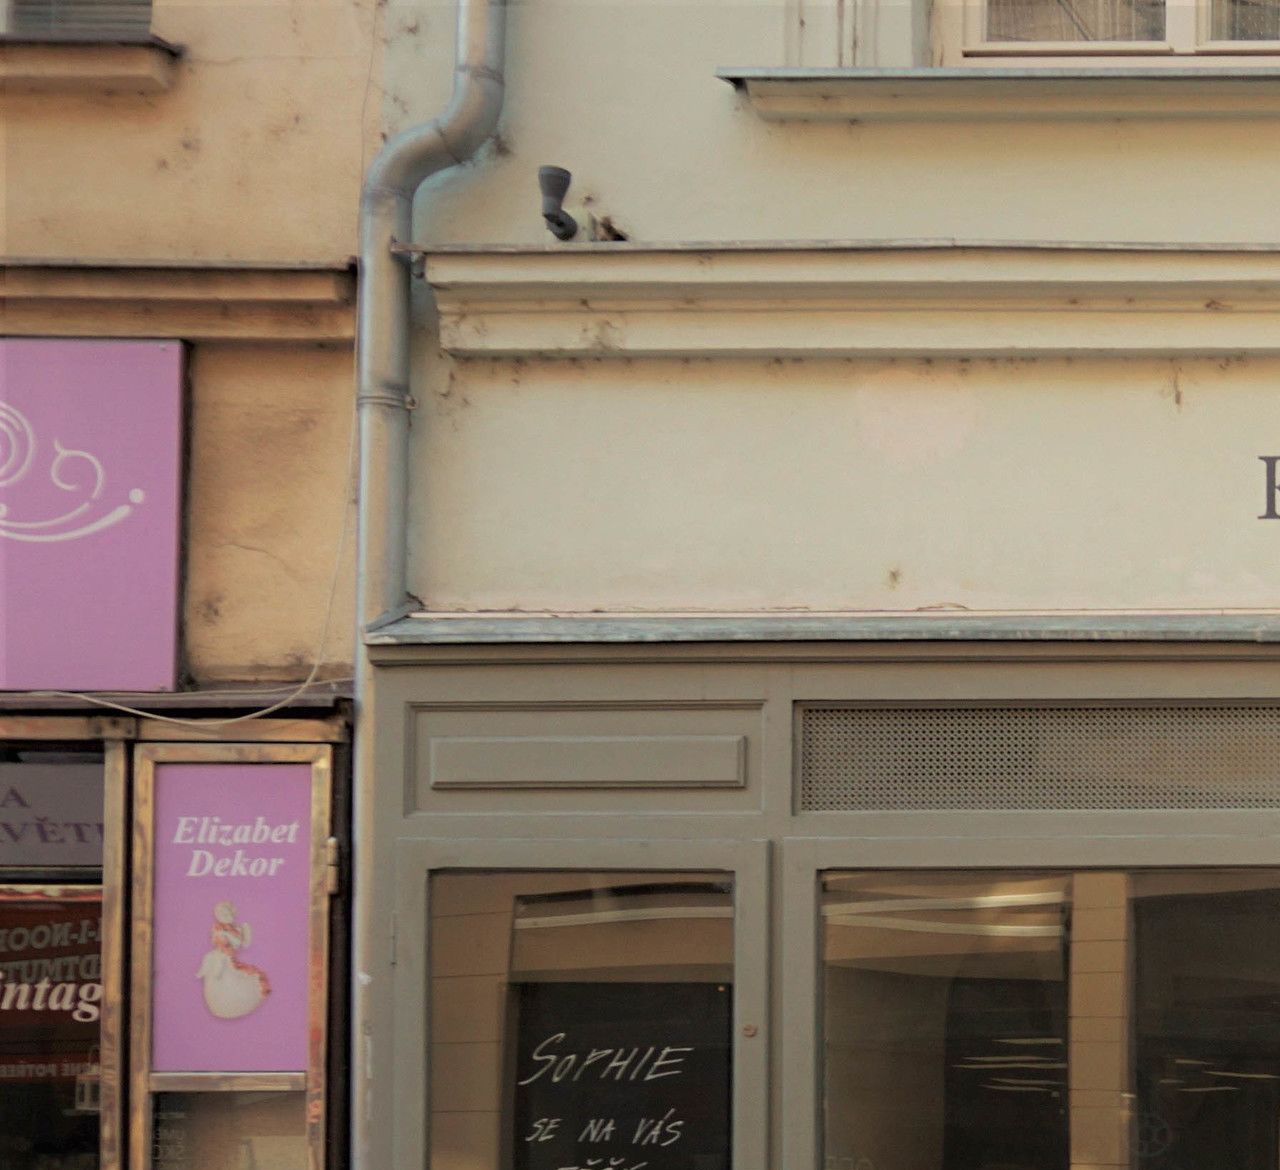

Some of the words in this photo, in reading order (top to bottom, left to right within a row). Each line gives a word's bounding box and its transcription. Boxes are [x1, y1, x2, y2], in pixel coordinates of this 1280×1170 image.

[172, 815, 300, 845] Elizabet
[185, 849, 286, 878] Dekor
[517, 1032, 696, 1086] SOPHIE
[525, 1118, 563, 1142] SE
[577, 1118, 617, 1144] NA
[632, 1107, 686, 1147] VÁS
